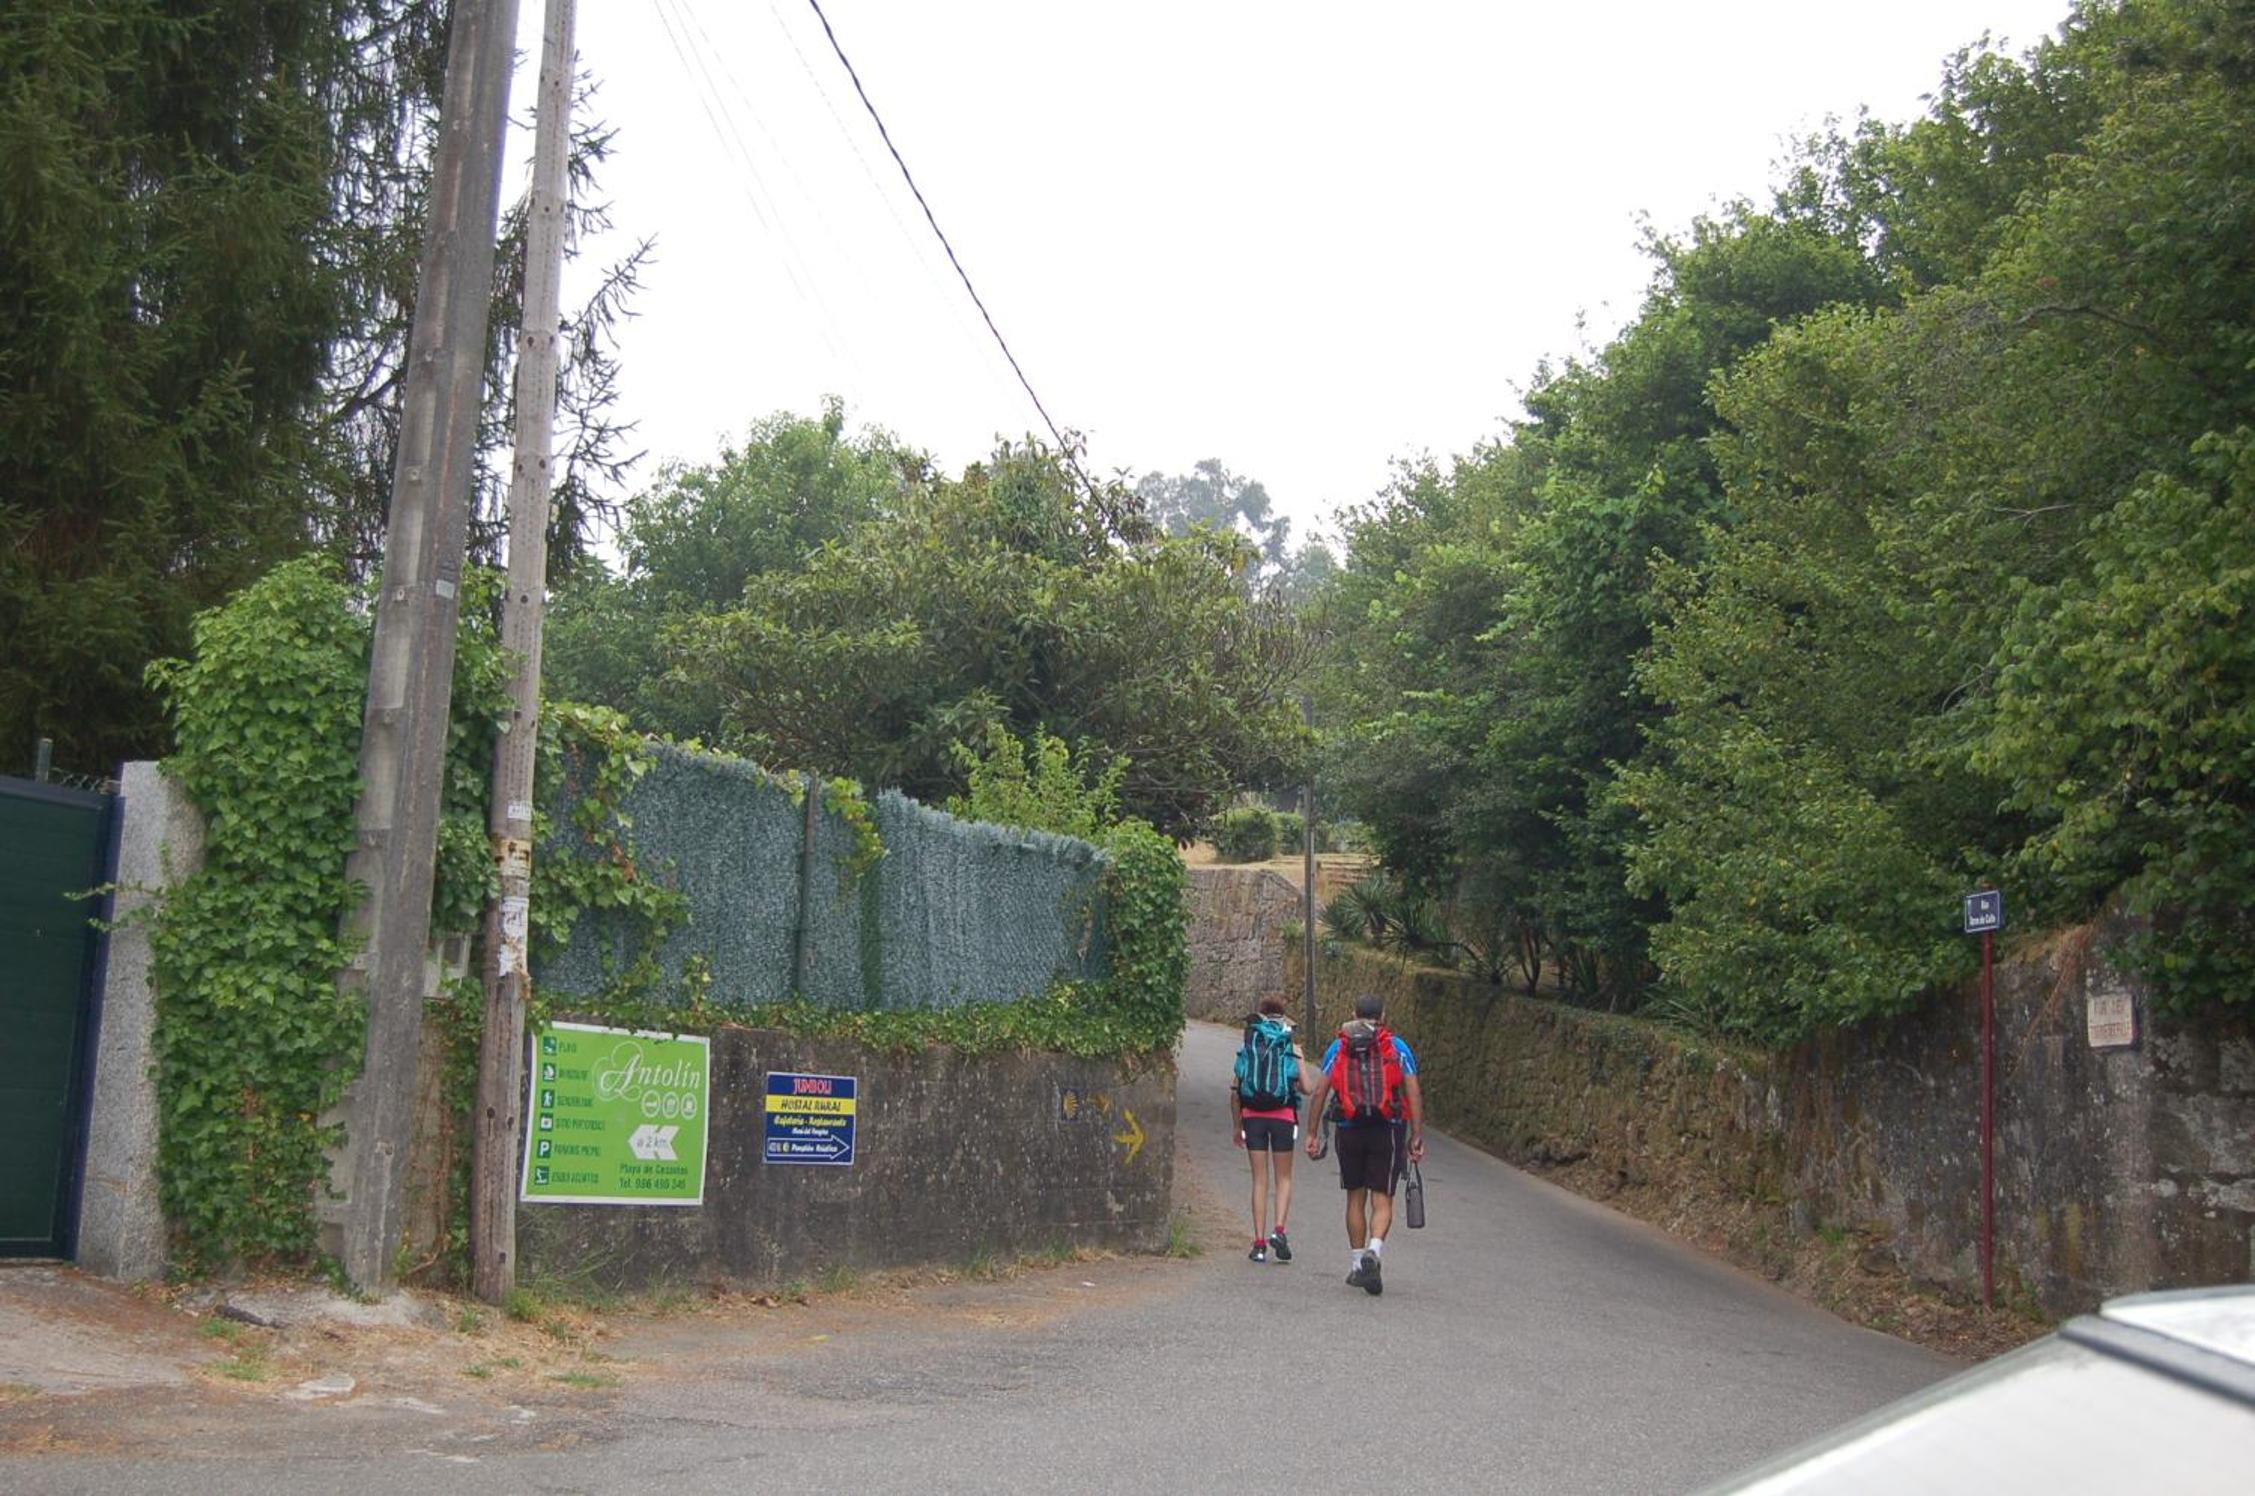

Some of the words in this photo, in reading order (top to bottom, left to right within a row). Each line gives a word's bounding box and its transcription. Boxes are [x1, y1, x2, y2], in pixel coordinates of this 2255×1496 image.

[592, 1041, 700, 1103] Antolín
[782, 1100, 811, 1112] HOSTAL
[813, 1101, 840, 1112] RURAL
[645, 1135, 653, 1148] 2
[540, 1141, 550, 1157] P
[620, 1163, 641, 1176] Playa
[643, 1165, 653, 1175] de
